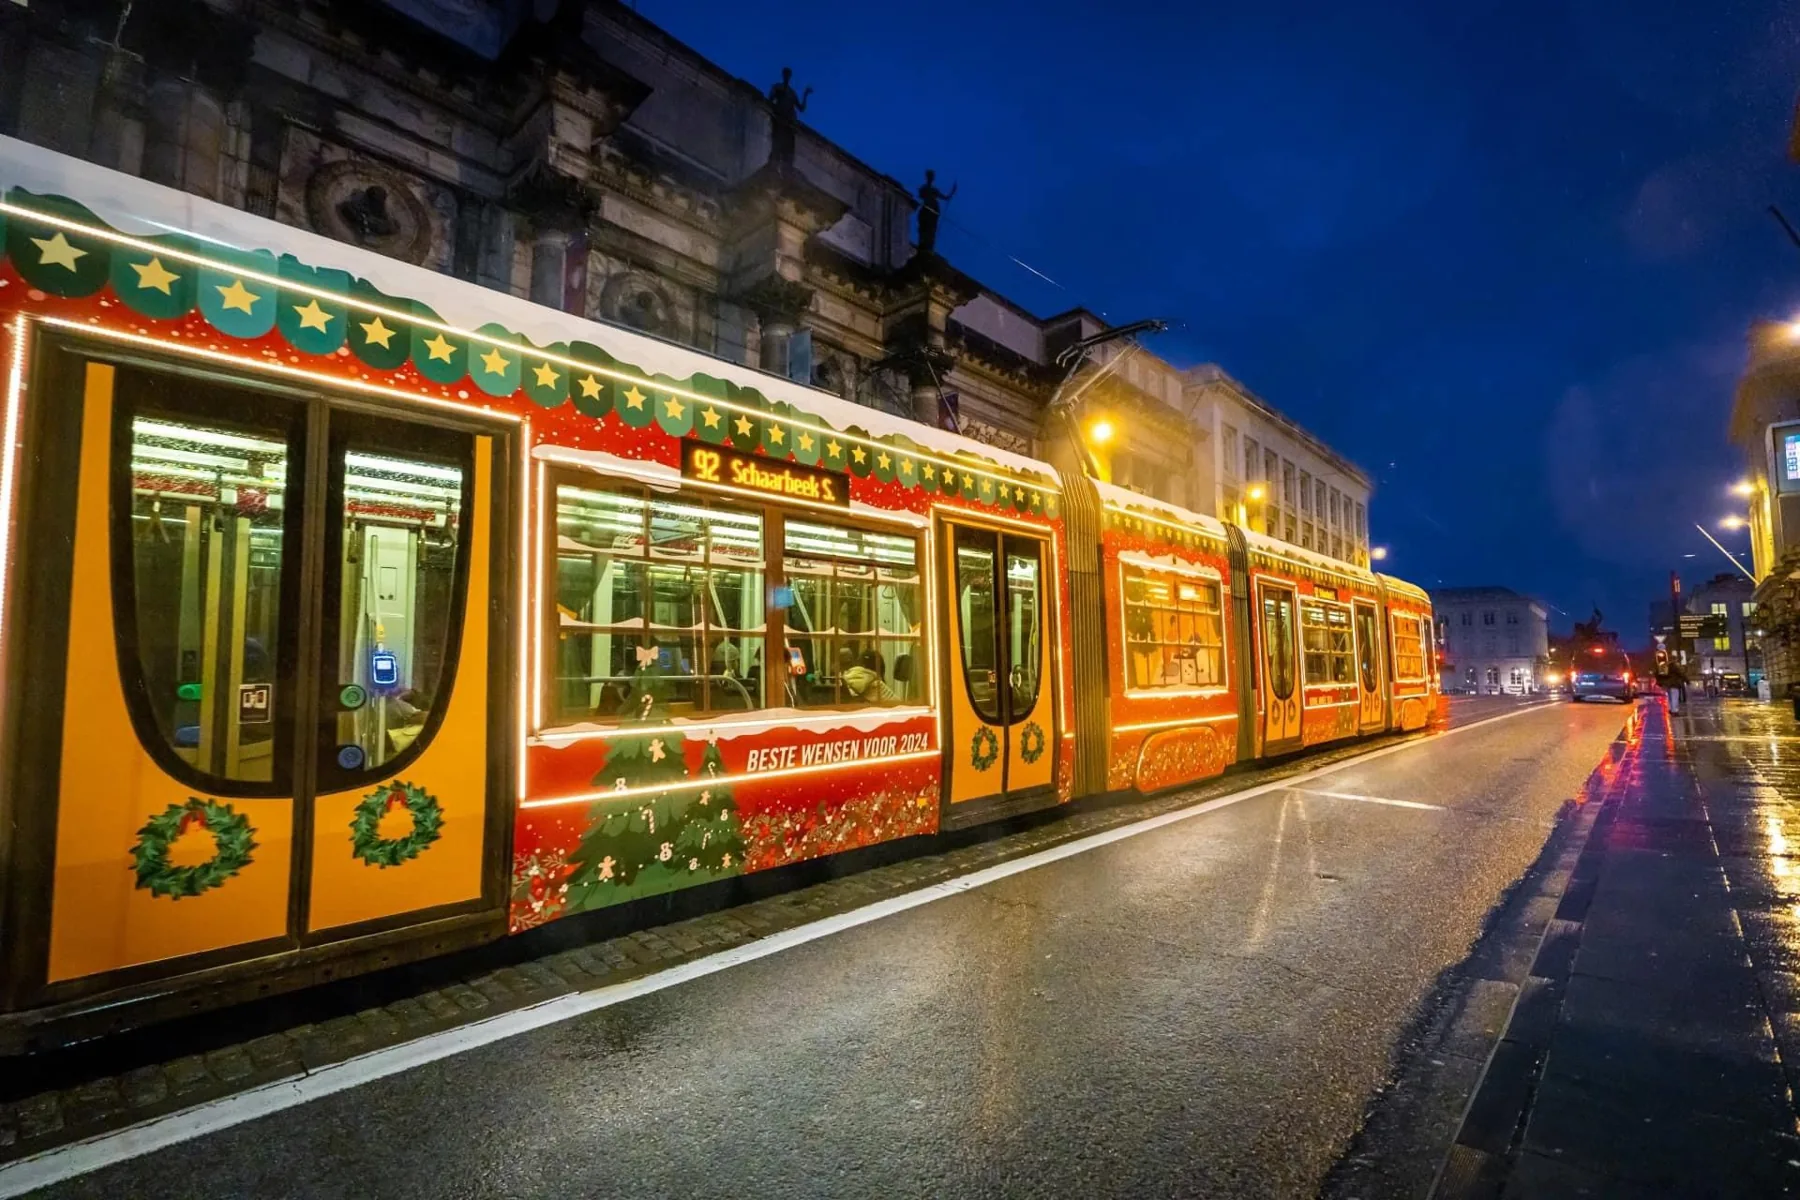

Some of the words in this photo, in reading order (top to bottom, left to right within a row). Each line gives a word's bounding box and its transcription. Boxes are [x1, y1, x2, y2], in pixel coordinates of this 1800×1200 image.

[693, 449, 720, 482] 92
[730, 459, 820, 499] Schaarbeek
[747, 745, 798, 773] BESTE
[801, 739, 860, 766] WENSEN
[863, 735, 897, 758] VOOR
[900, 732, 929, 754] 2024
